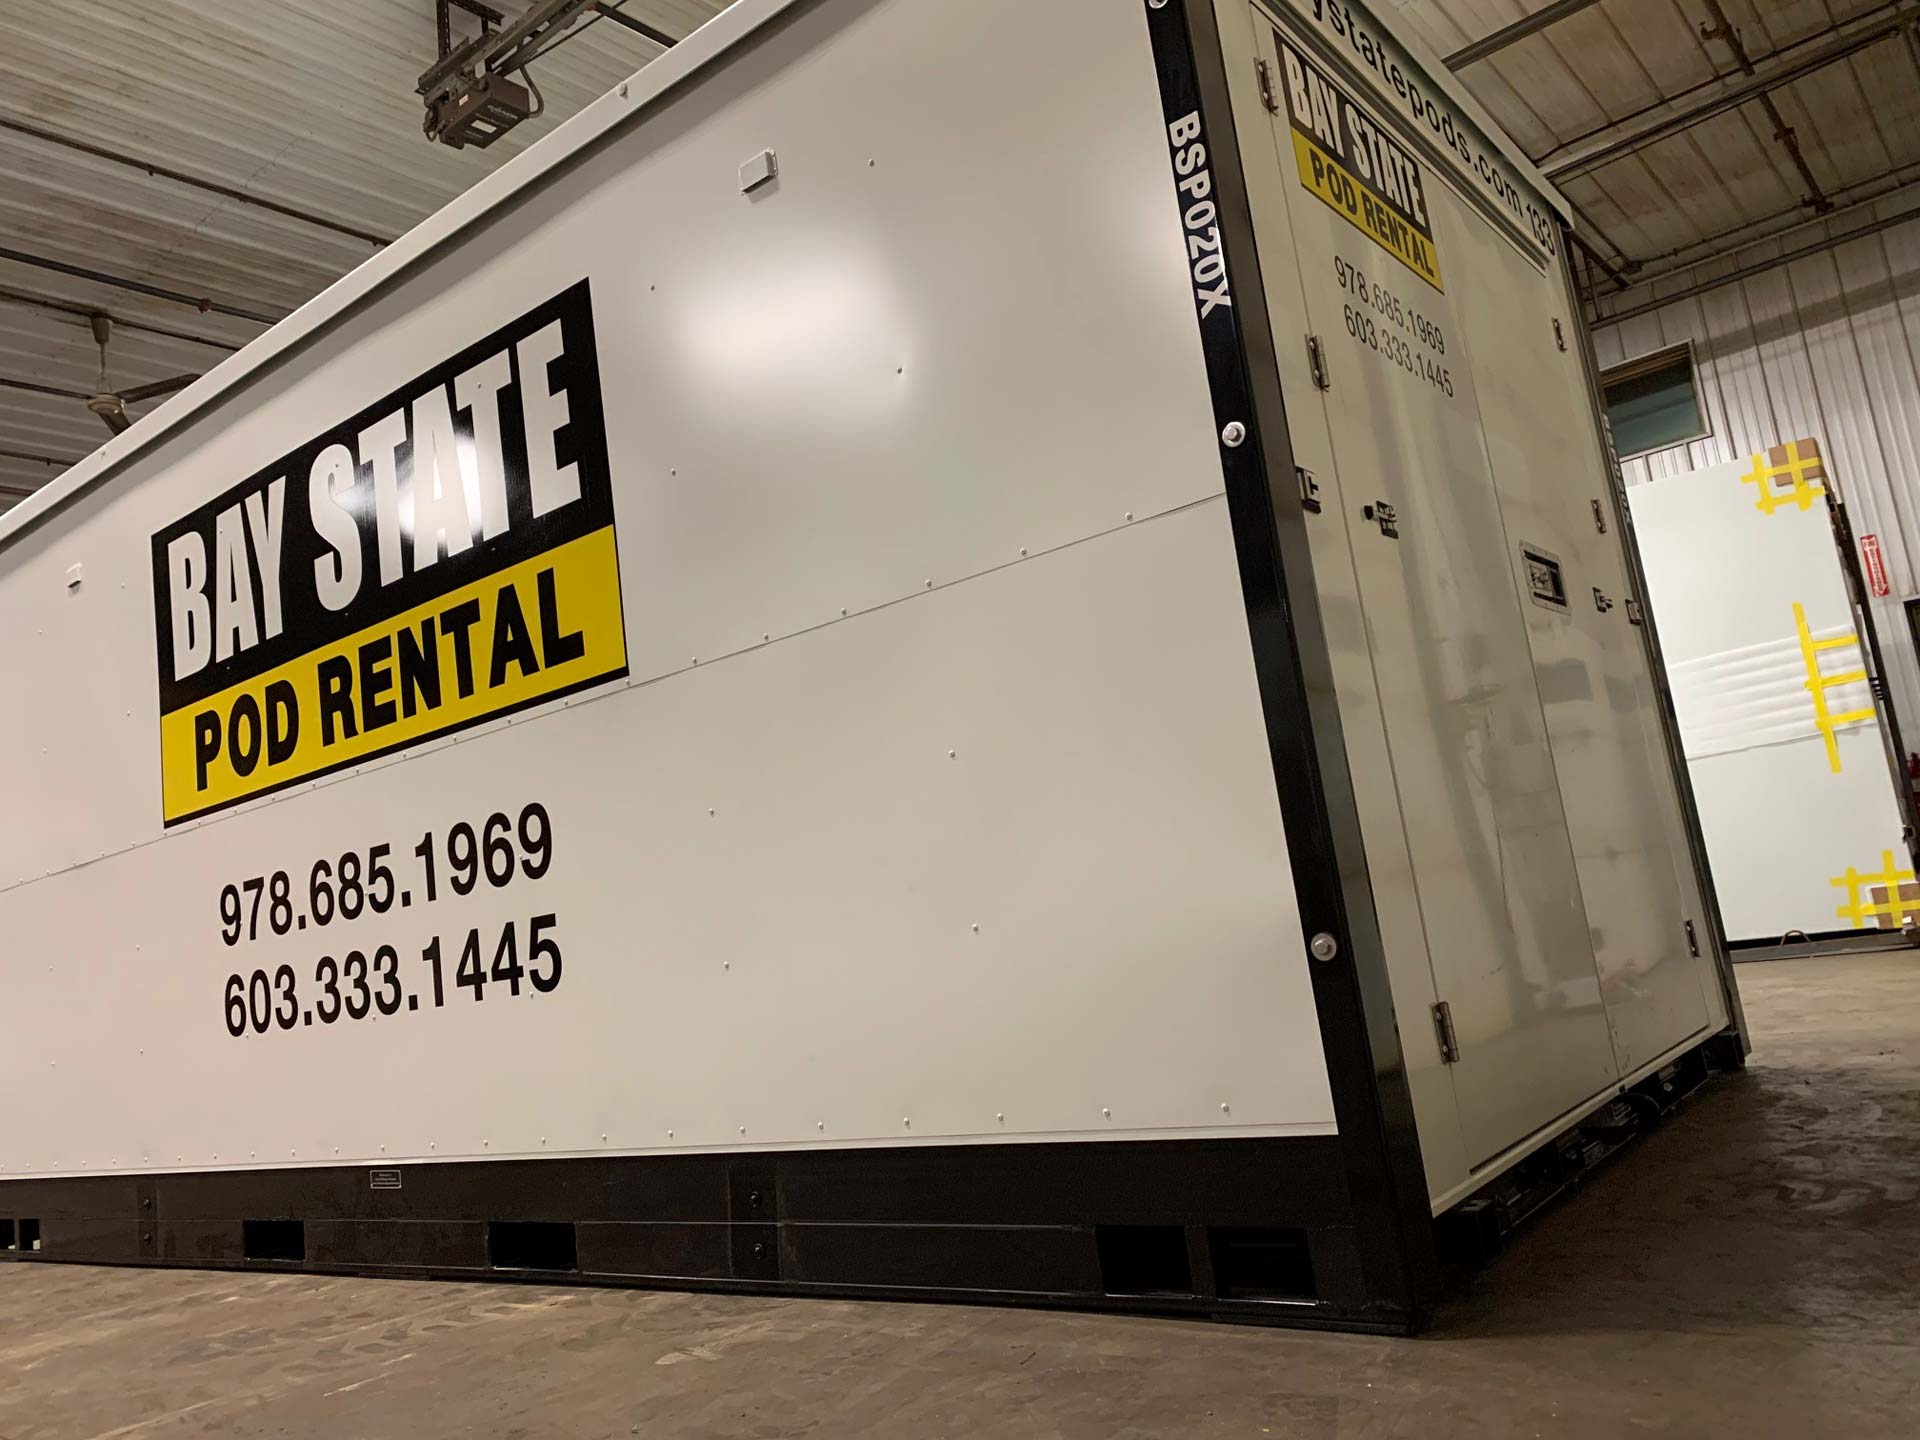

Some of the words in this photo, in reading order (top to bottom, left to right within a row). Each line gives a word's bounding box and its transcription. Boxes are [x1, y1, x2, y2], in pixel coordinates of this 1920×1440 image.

[1281, 43, 1345, 158] BAY
[1345, 103, 1427, 228] STATE
[1168, 110, 1232, 319] BSP020X
[1310, 148, 1358, 216] POD
[1365, 193, 1435, 278] RENTAL
[1526, 203, 1555, 256] 133
[1334, 255, 1445, 355] 978.685.1969
[1344, 303, 1454, 398] 603.333.1445
[168, 475, 286, 682] BAY
[308, 318, 582, 612] STATE
[194, 678, 300, 792] POD
[317, 566, 586, 748] RENTAL
[219, 802, 553, 946] 978.685.1969
[224, 913, 563, 1038] 603.333.1445
